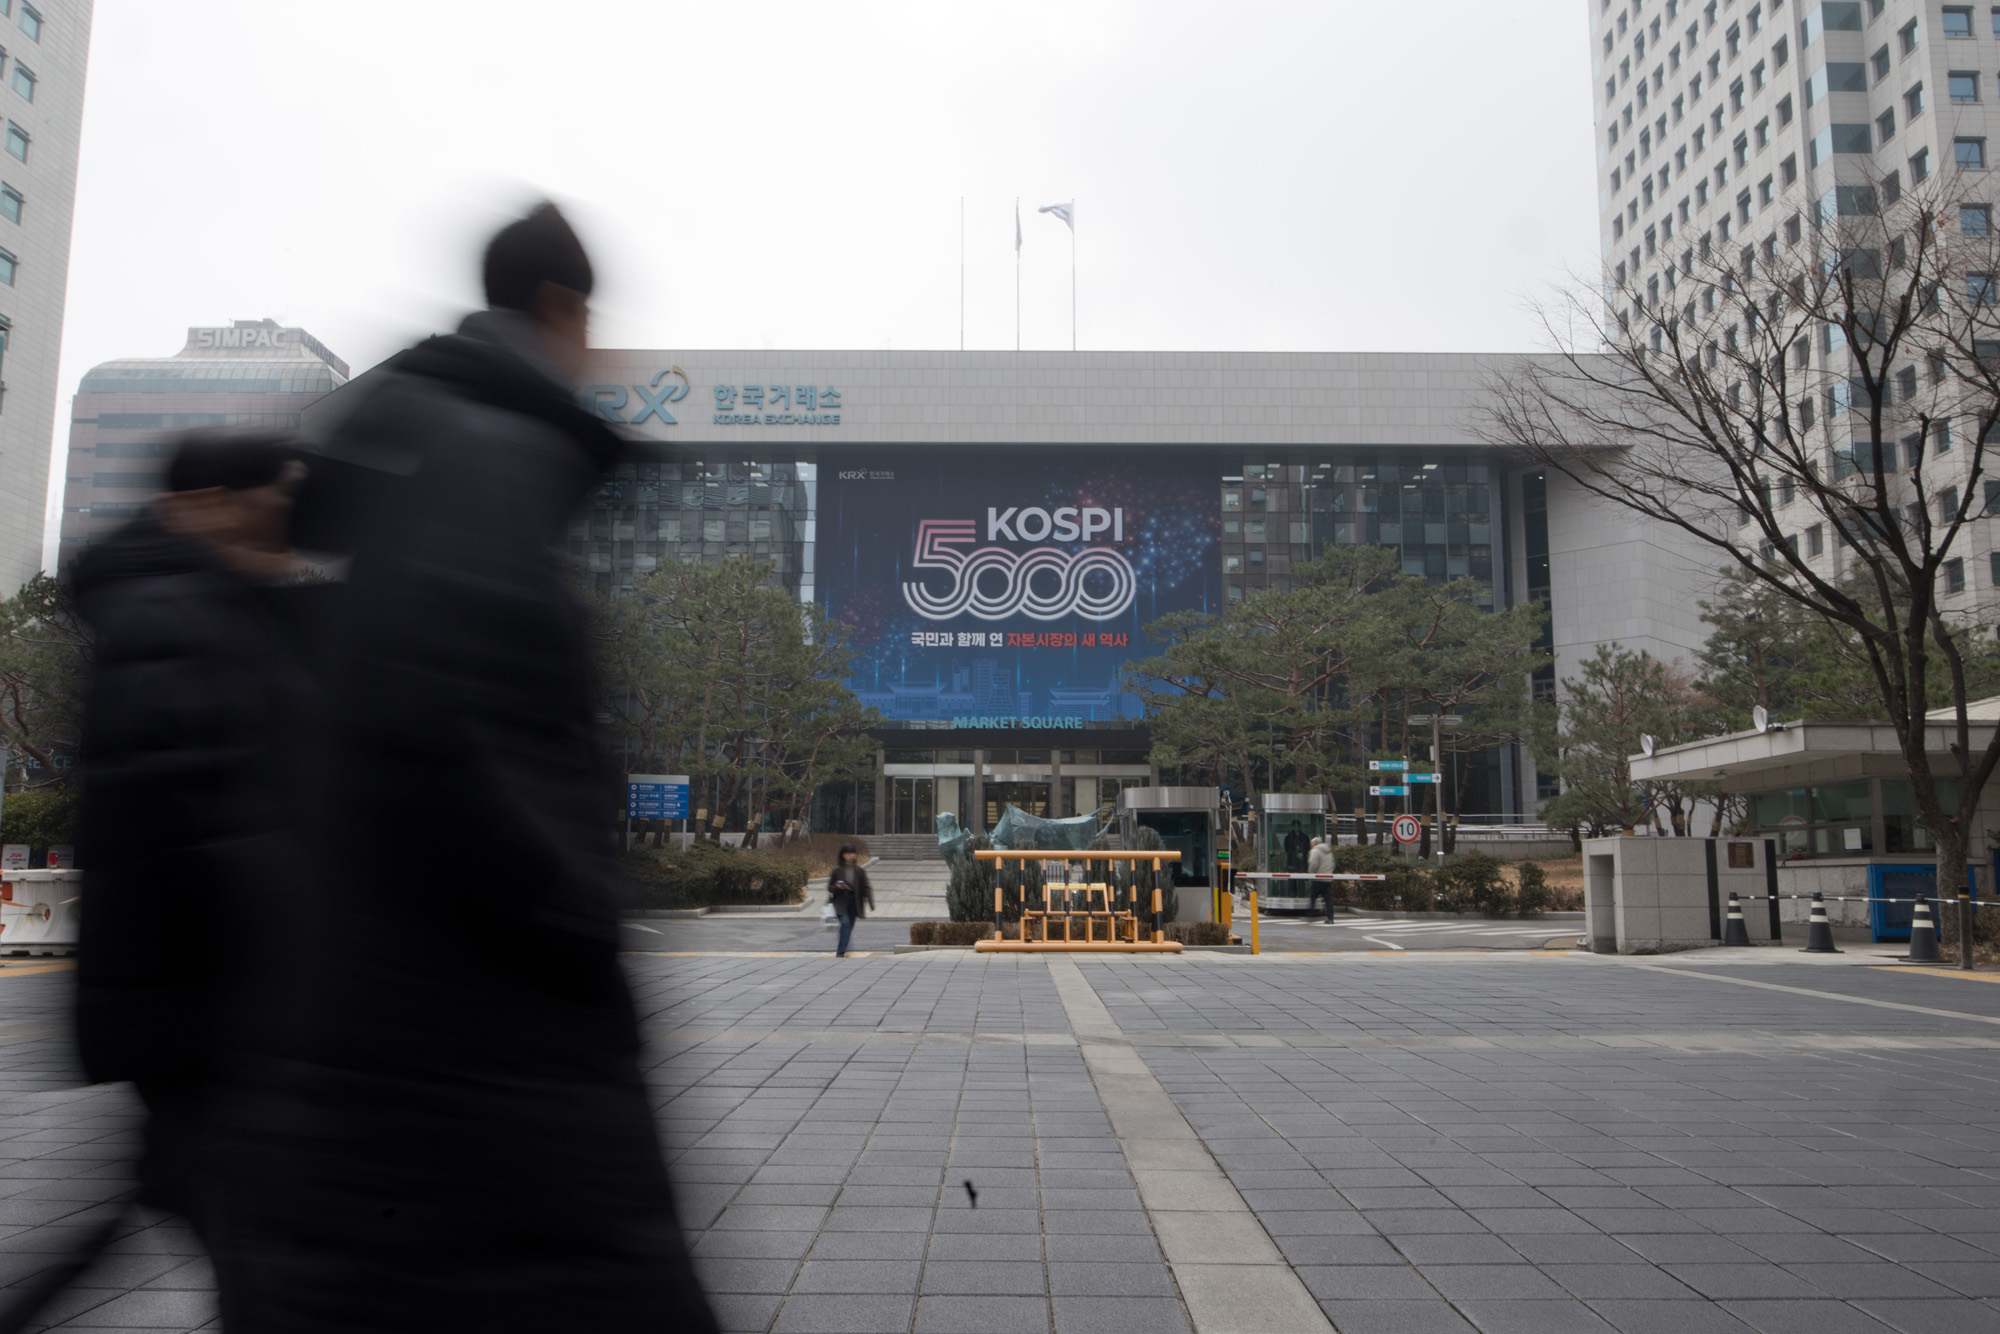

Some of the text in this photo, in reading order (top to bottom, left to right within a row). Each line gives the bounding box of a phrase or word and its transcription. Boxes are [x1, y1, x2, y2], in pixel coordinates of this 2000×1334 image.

[198, 328, 288, 349] SIMPAC
[577, 380, 684, 425] RX
[713, 384, 842, 411] 한국거래소
[713, 414, 841, 425] KOREA EXCHANGE
[838, 470, 867, 480] KRX
[987, 506, 1124, 543] KOSPI
[902, 520, 1137, 621] 5000
[911, 632, 1129, 647] 국민과 함께 연 자본시장의 새 역사
[953, 716, 1084, 729] MARKET SQUARE
[1399, 822, 1415, 835] 10
